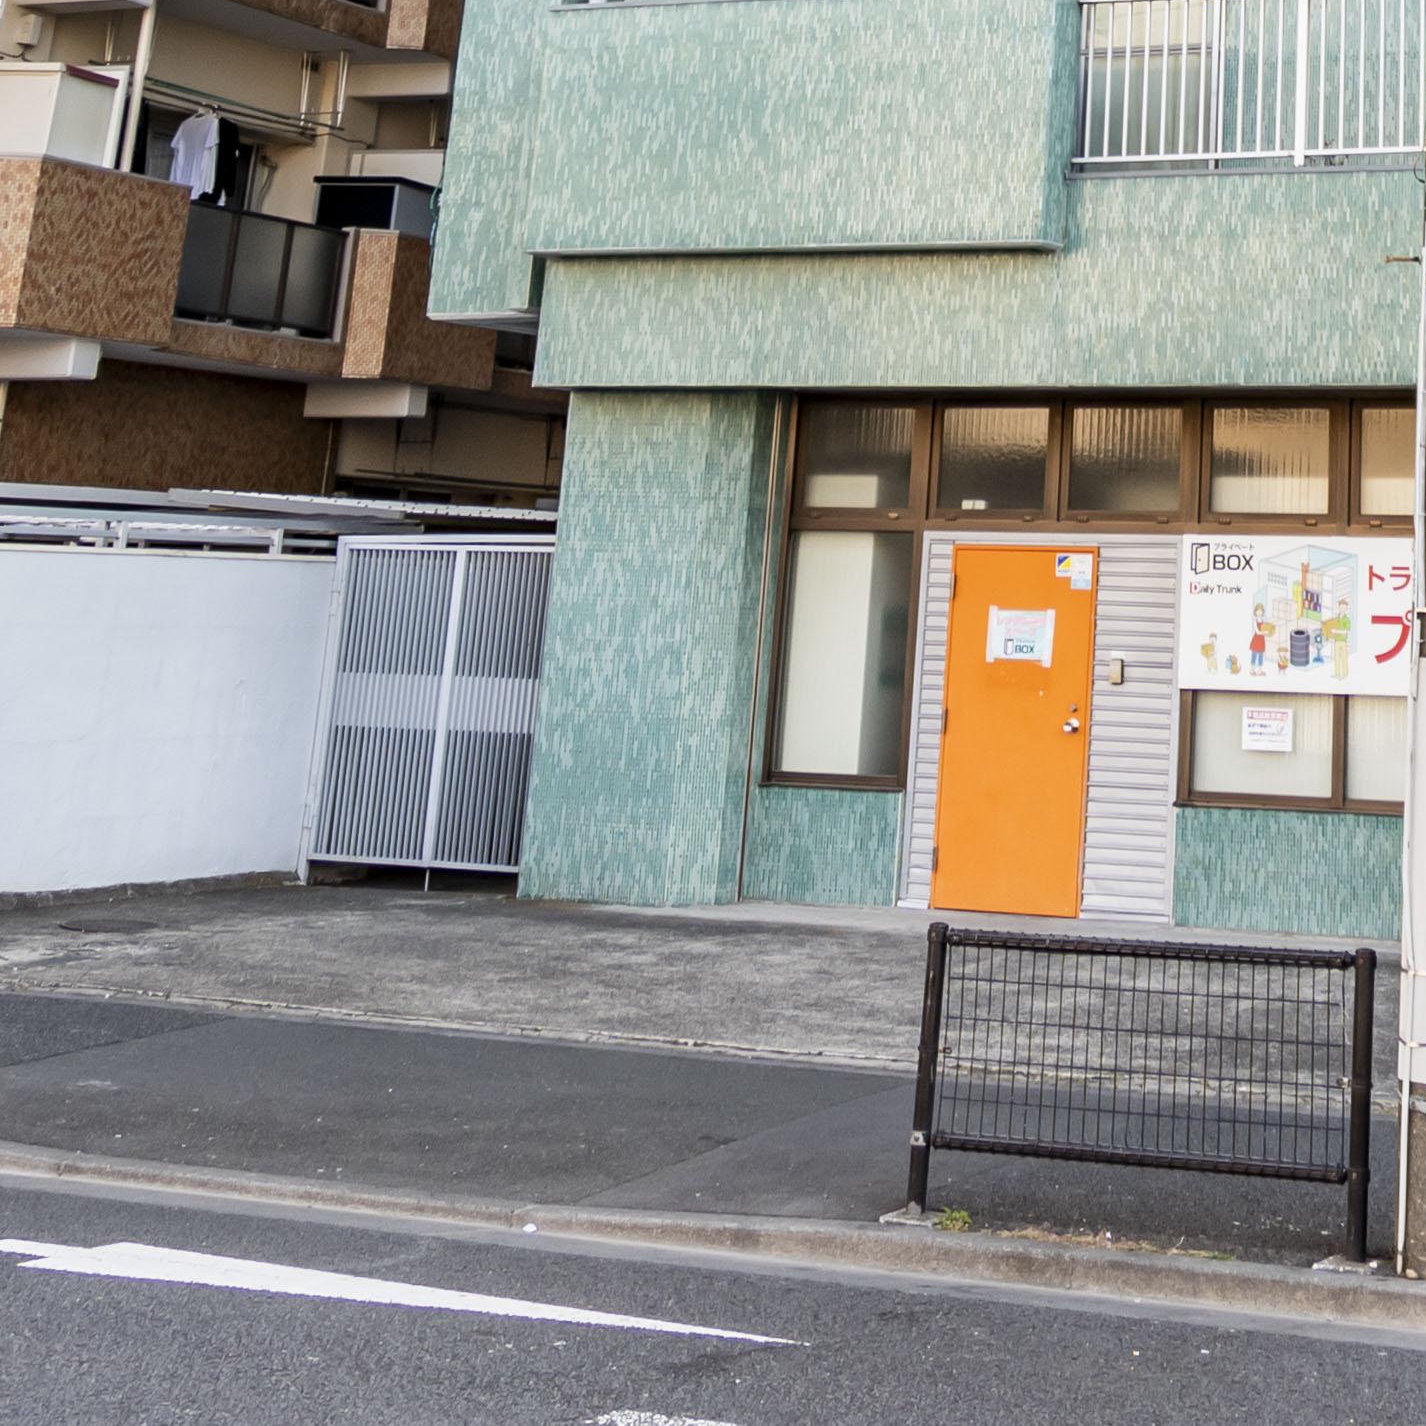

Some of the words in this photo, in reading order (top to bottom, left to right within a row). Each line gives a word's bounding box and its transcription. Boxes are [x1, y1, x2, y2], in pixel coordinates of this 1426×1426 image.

[1213, 554, 1254, 571] BOX
[1189, 582, 1215, 595] Daily
[1217, 584, 1242, 594] Trunk
[1015, 644, 1035, 654] BOX
